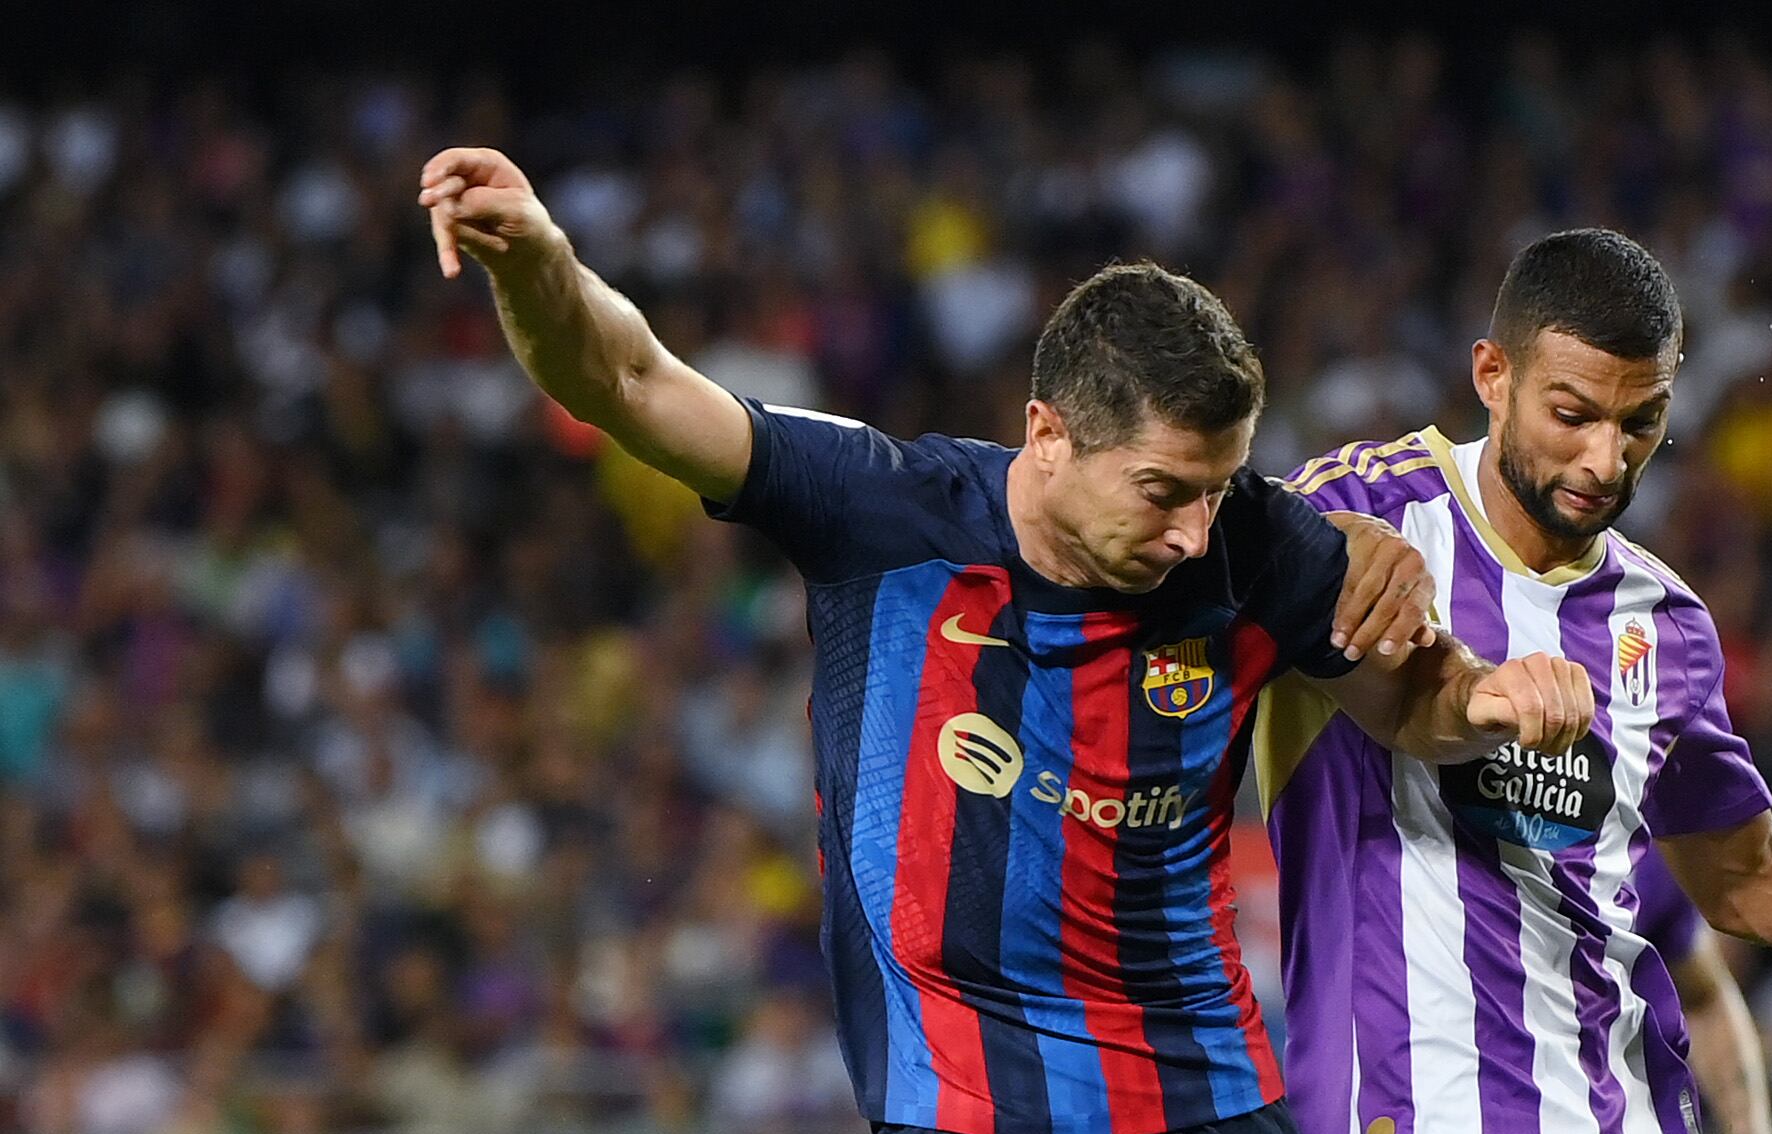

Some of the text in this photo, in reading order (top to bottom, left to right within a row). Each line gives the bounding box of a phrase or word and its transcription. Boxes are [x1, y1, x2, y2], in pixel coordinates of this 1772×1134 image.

[1163, 670, 1190, 684] FCB
[1030, 771, 1199, 831] Spotify
[1478, 763, 1583, 818] Galicia
